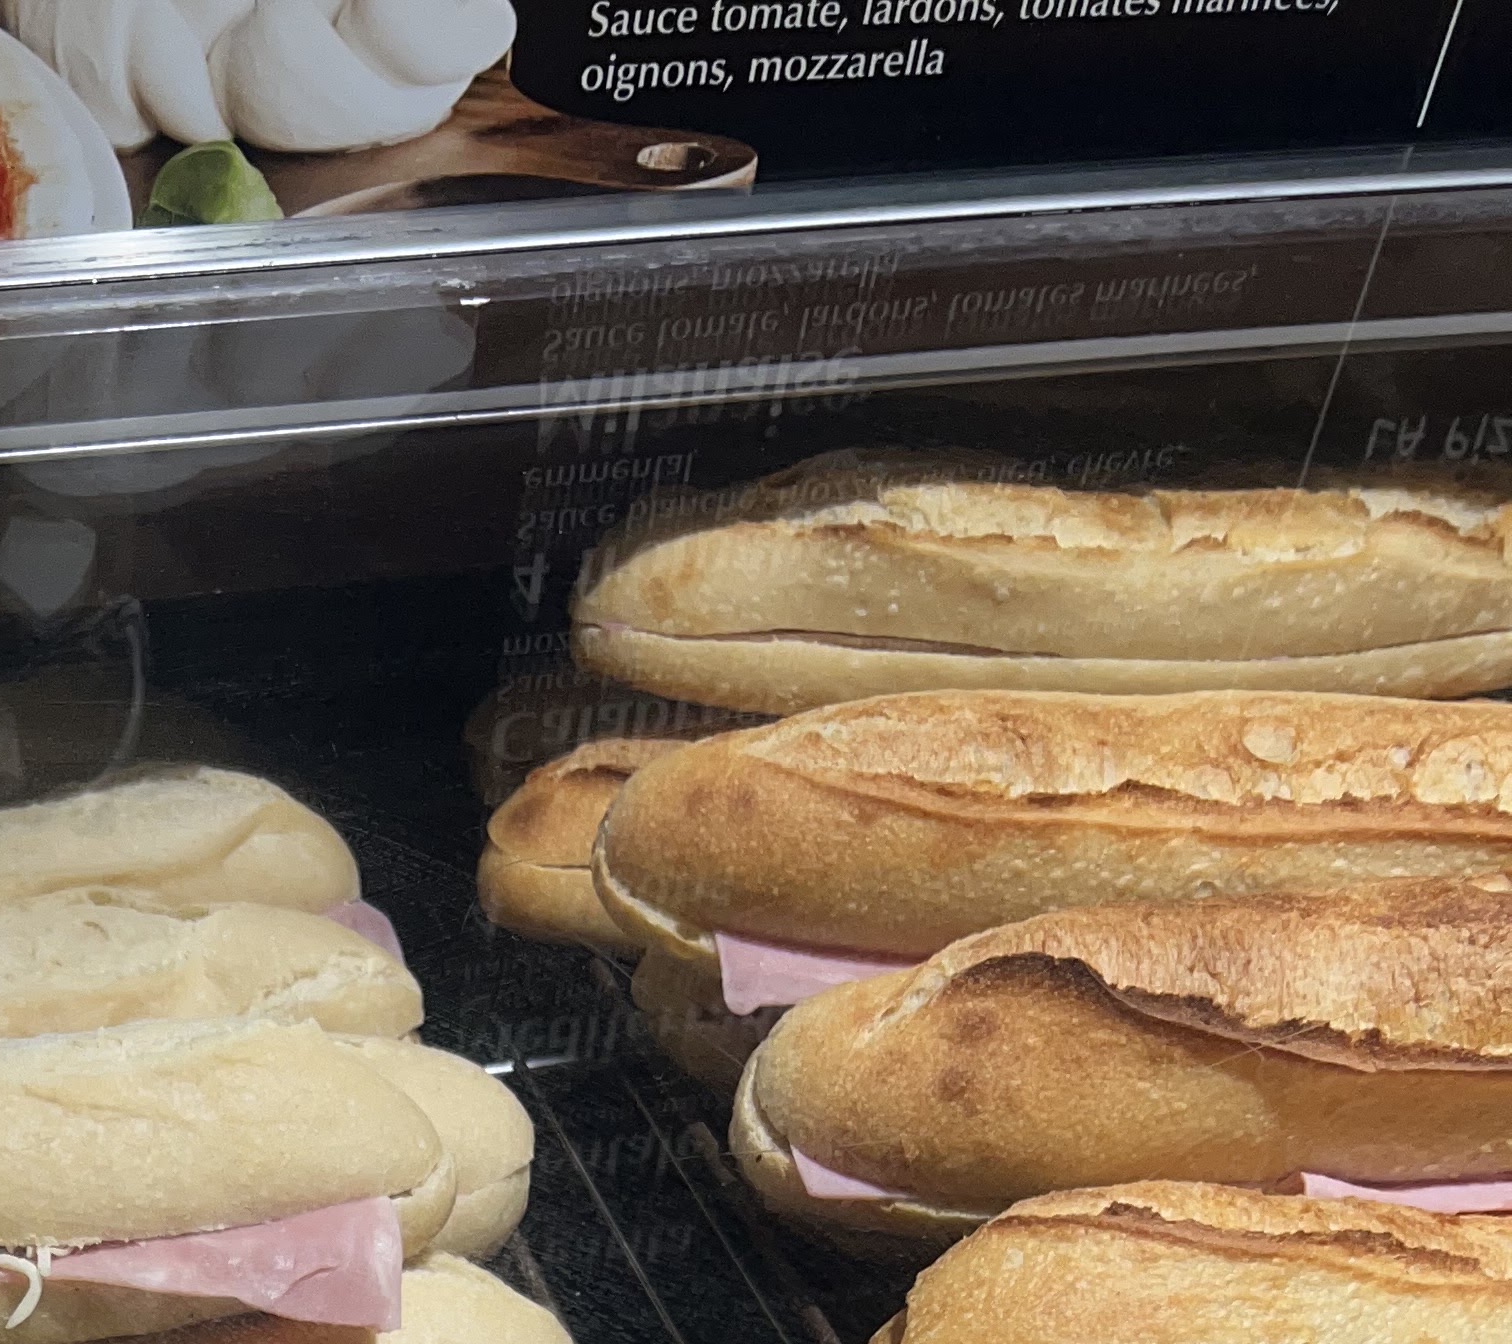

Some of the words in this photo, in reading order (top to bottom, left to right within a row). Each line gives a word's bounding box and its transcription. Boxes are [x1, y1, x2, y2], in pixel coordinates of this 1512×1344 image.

[587, 0, 698, 37] Sauce
[710, 0, 849, 34] tomate,
[862, 0, 1004, 29] lardons,
[580, 53, 734, 102] oignons,
[747, 38, 945, 83] mozzarella
